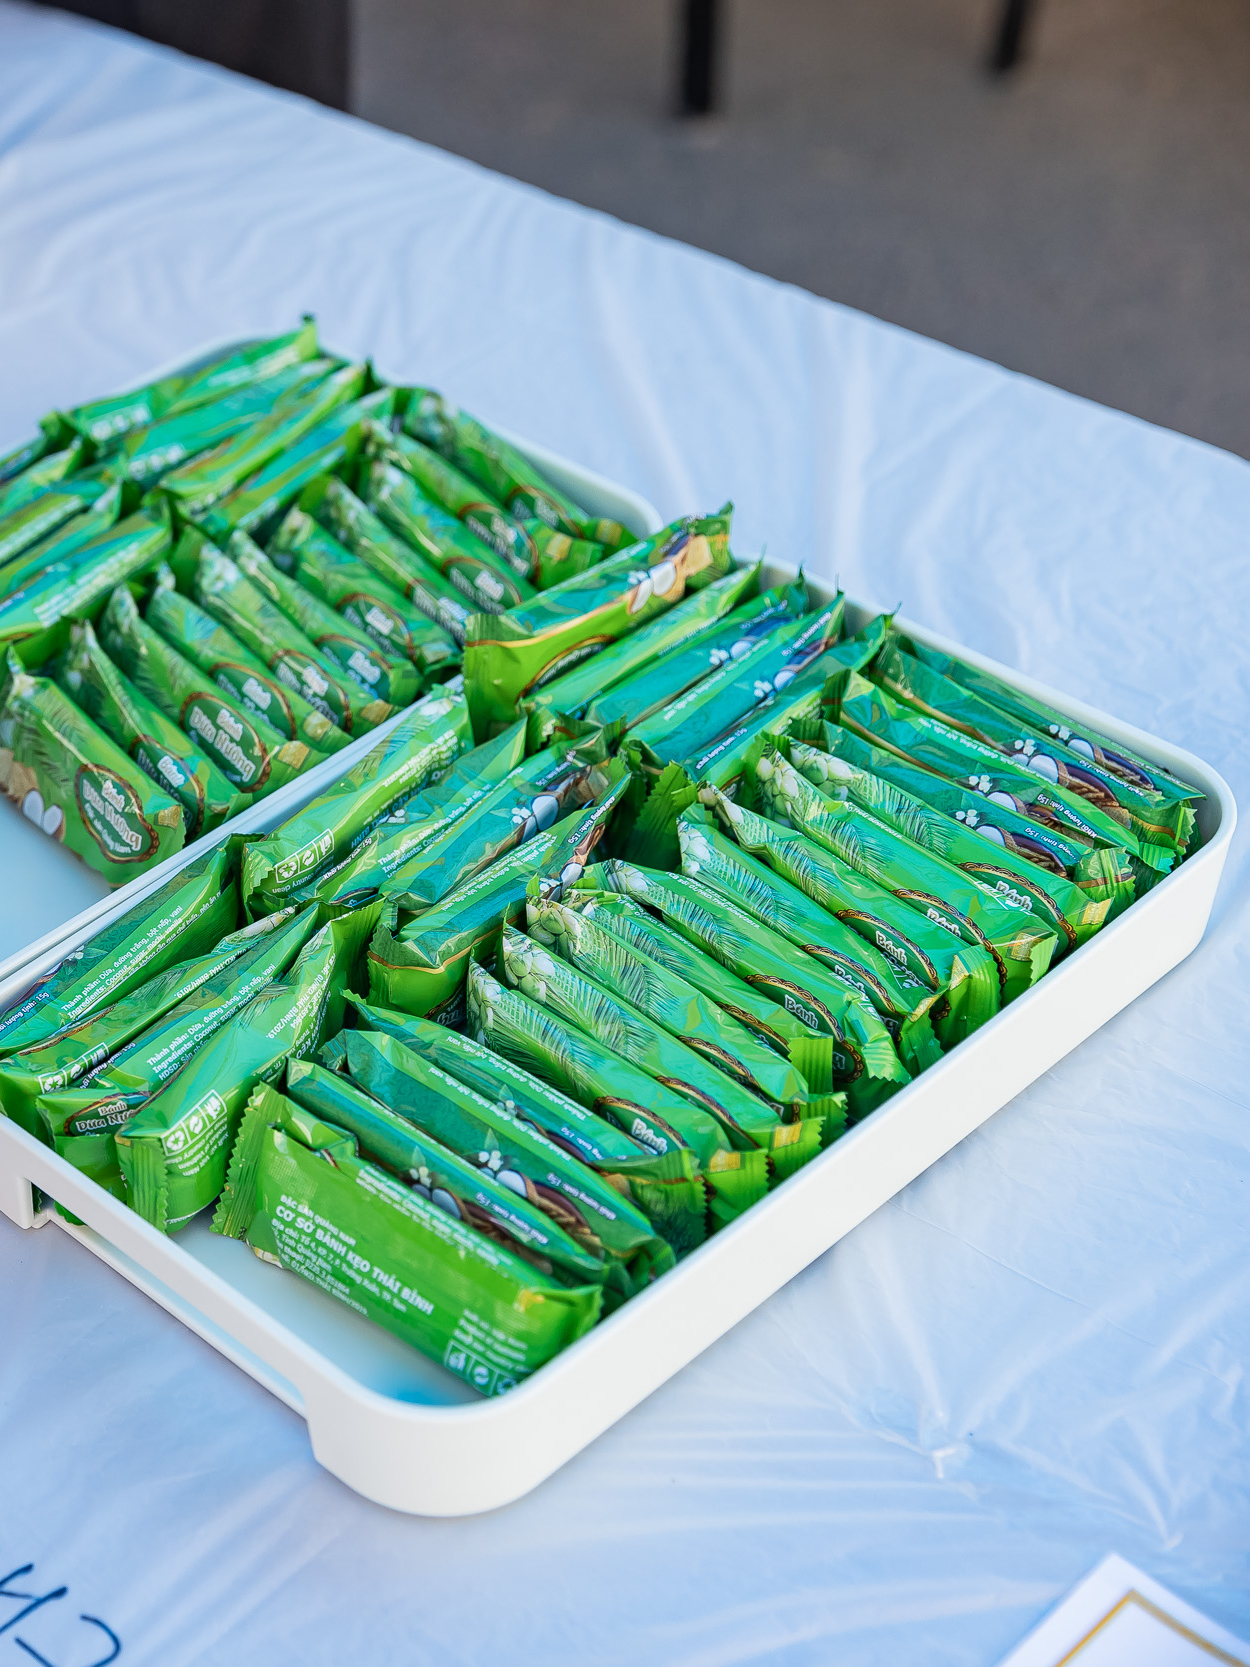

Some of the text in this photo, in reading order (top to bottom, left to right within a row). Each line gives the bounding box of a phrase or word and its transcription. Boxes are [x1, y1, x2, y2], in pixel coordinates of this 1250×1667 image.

[216, 708, 244, 742] Bánh
[735, 728, 748, 737] 15g
[189, 706, 257, 783] Dừa Nướng
[1079, 758, 1093, 769] 15g
[101, 780, 126, 813] Bánh
[590, 805, 606, 821] lượng
[82, 778, 143, 853] Dừa Nướng
[579, 819, 594, 833] tịnh:
[1037, 793, 1097, 839] Khối lượng tịnh: 15g
[377, 845, 401, 865] Thành
[399, 836, 420, 854] phần:
[567, 832, 581, 844] 15g
[1025, 827, 1058, 846] tịnh: 15g
[323, 867, 338, 880] Khối
[361, 836, 373, 848] 15g
[382, 840, 422, 873] Ingredients:
[272, 879, 291, 894] clean
[61, 905, 183, 1011] Thành phần: Dừa, đường trắng, bột nếp, vani
[875, 930, 907, 966] Bánh
[67, 985, 108, 1019] Ingredients:
[105, 964, 130, 986] Coconut,
[145, 933, 166, 951] mochi,
[164, 917, 183, 934] vanilla
[4, 1011, 24, 1026] lượng
[21, 1000, 37, 1013] tịnh:
[35, 992, 50, 1001] 15g
[146, 1048, 170, 1066] Thành
[169, 1033, 189, 1051] phần:
[187, 1023, 205, 1035] Dừa,
[203, 1007, 224, 1024] đường
[238, 985, 251, 996] bột
[249, 976, 264, 988] nếp,
[262, 963, 276, 976] vani
[266, 1006, 299, 1039] BÌNH/2019.
[784, 993, 818, 1029] Bánh
[152, 1040, 195, 1074] Ingredients:
[193, 1020, 221, 1042] Coconut,
[219, 1006, 237, 1021] sugar,
[158, 1062, 181, 1081] HDSD:
[75, 1114, 107, 1132] Dừa
[97, 1100, 127, 1116] Bánh
[561, 1127, 575, 1138] 15g
[631, 1118, 668, 1156] Bánh
[338, 1231, 356, 1246] NAM
[276, 1205, 434, 1314] CƠ SỞ BÁNH KẸO THÁI BÌNH
